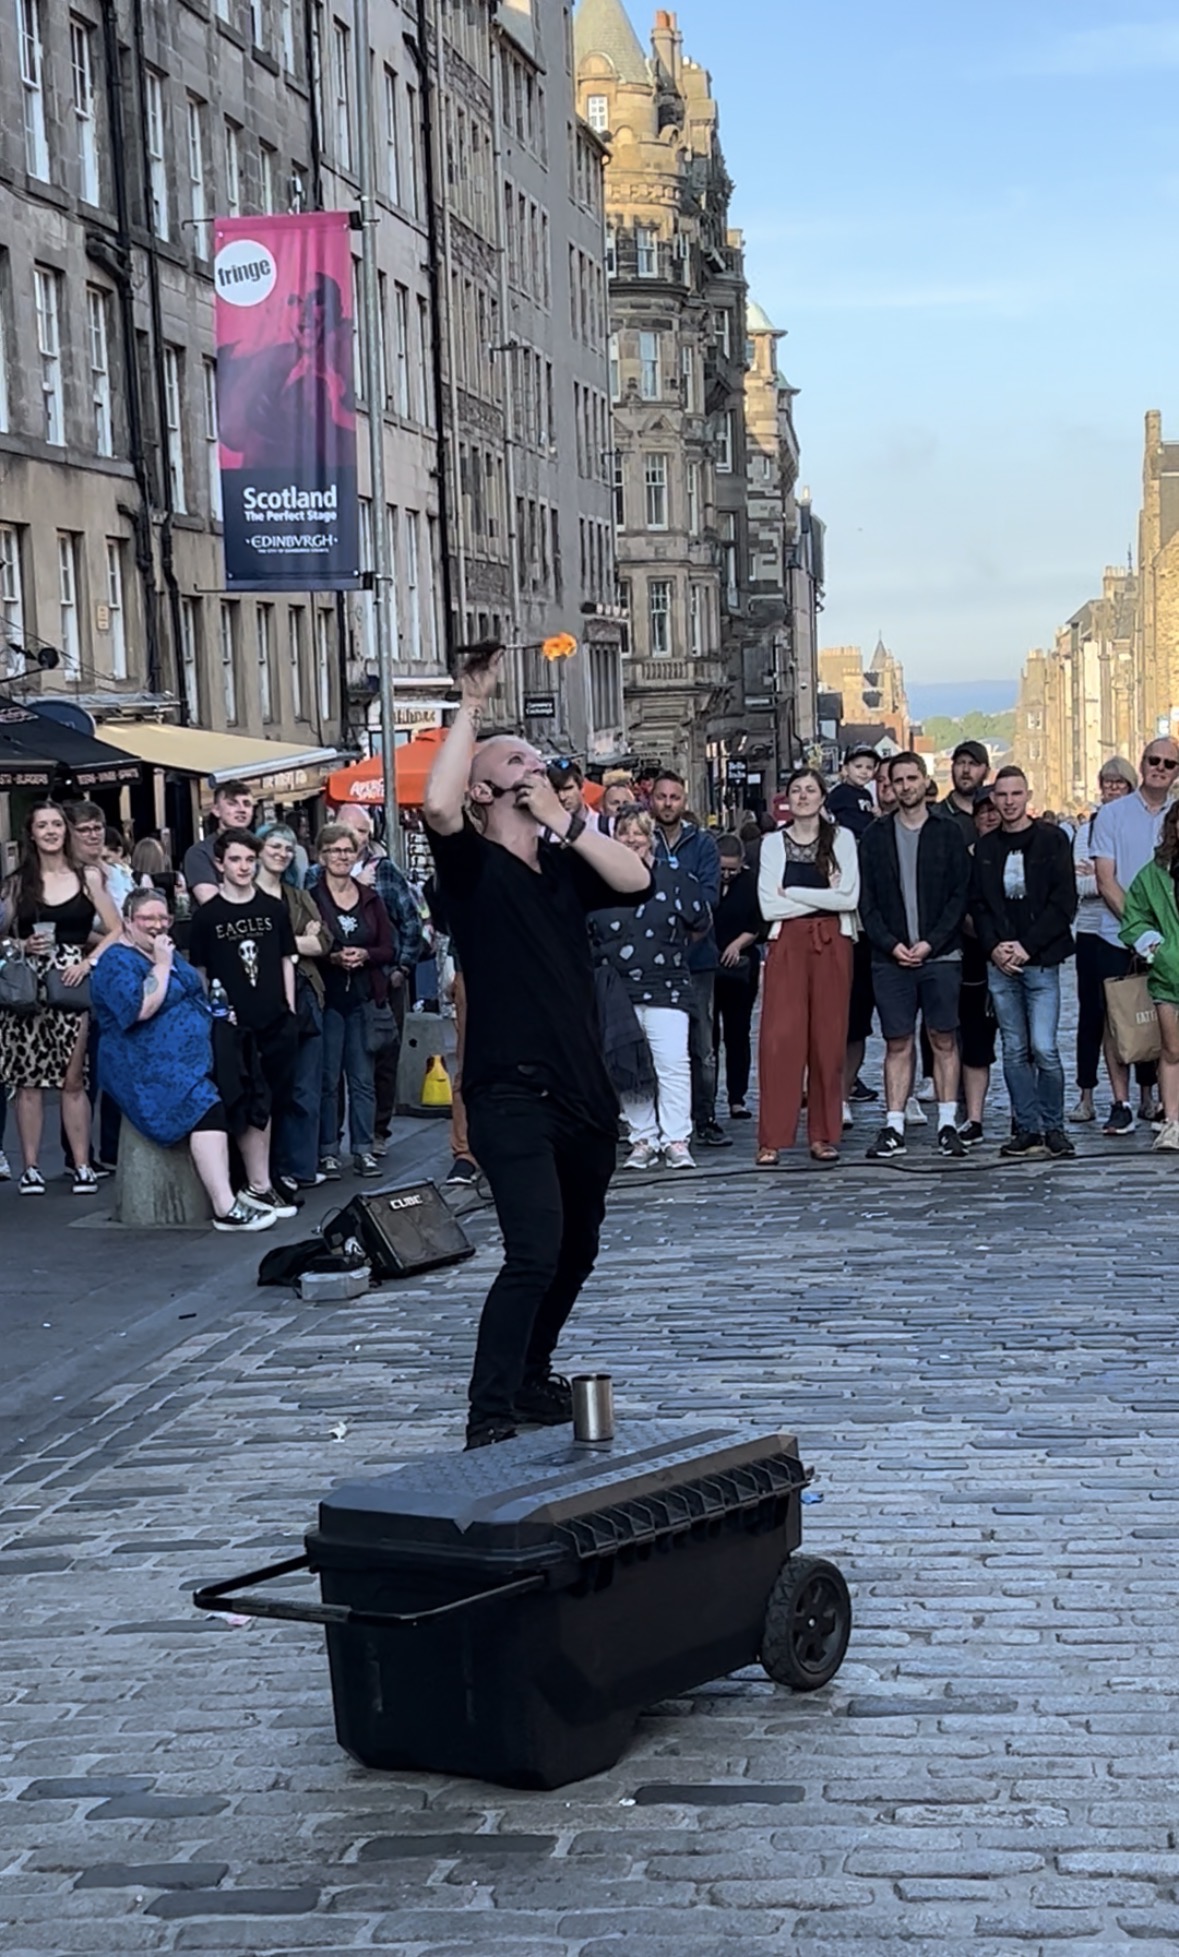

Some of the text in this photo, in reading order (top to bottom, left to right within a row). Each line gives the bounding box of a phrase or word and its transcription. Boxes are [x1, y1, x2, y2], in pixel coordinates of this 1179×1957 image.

[218, 259, 272, 287] fringe
[243, 484, 337, 509] Scotland
[244, 510, 337, 523] The Perfect Stage
[215, 917, 273, 939] EAGLES
